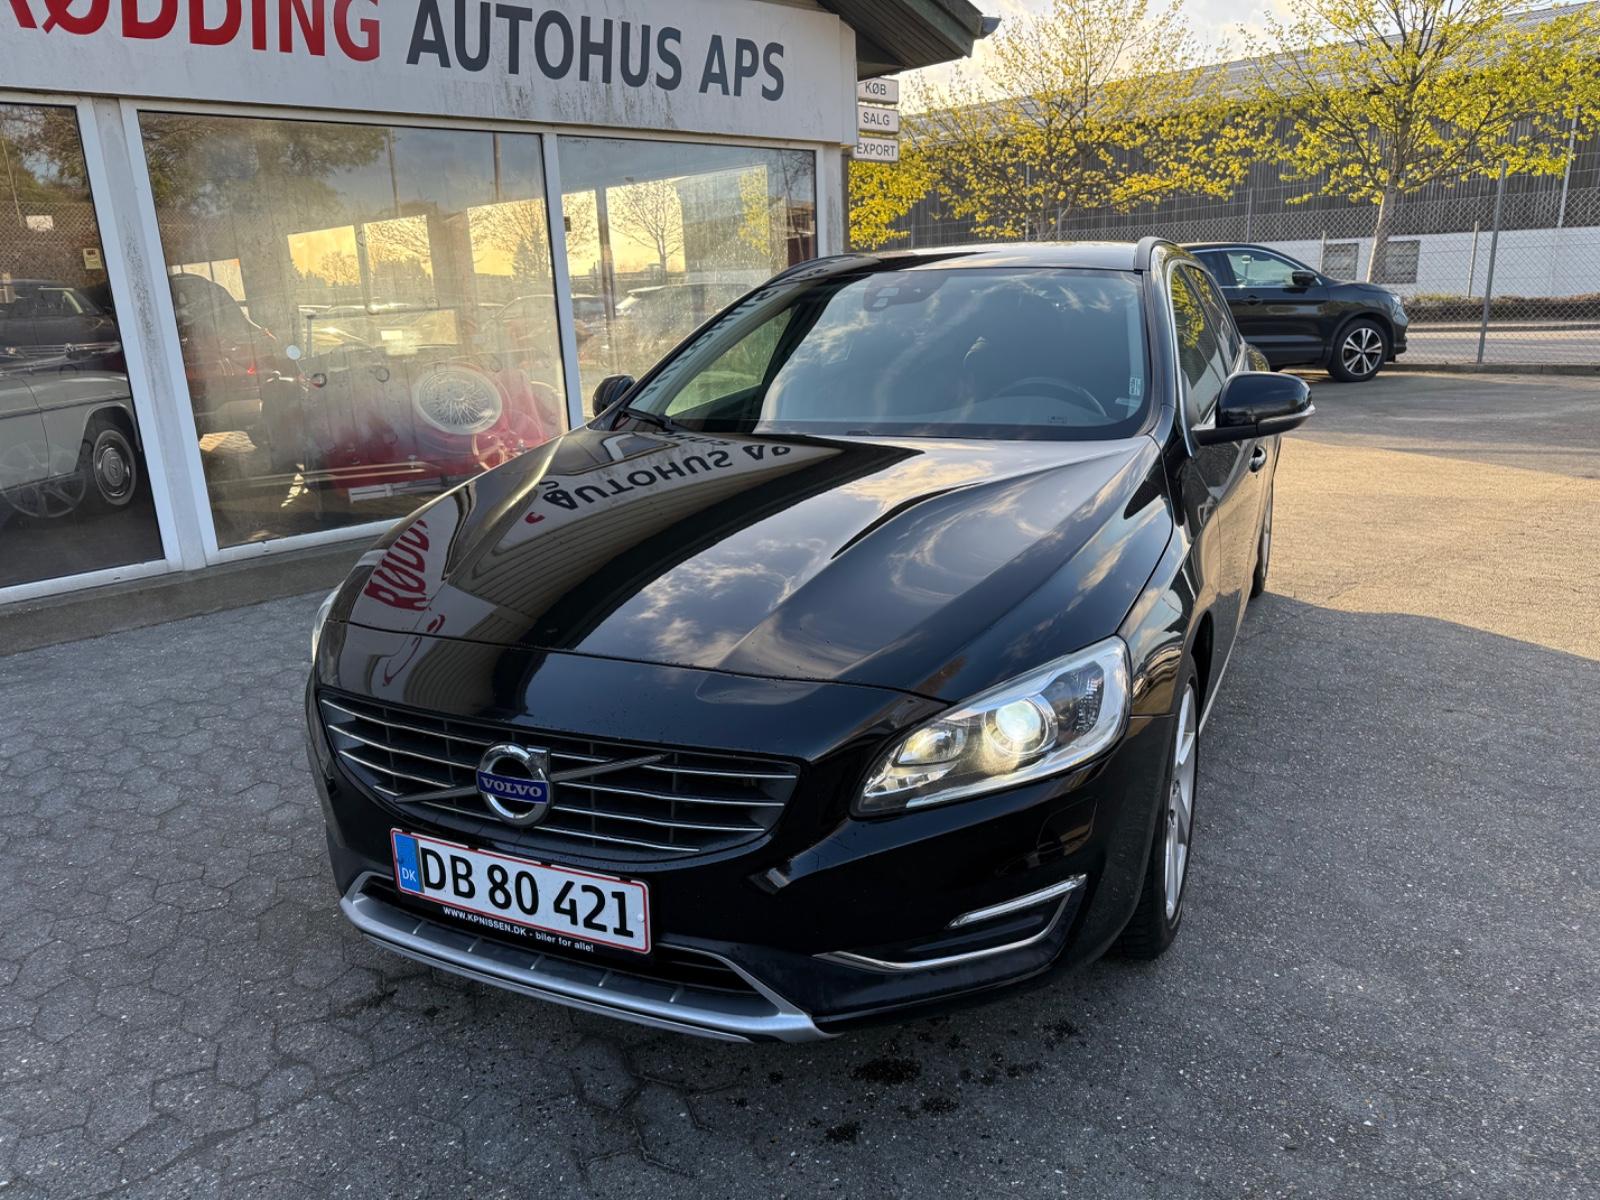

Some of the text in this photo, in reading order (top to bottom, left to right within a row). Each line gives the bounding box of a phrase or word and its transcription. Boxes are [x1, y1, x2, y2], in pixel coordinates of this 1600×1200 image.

[9, 0, 784, 101] DING AUTOHUS APS
[865, 82, 887, 96] KØB
[863, 111, 890, 126] SALG
[856, 142, 896, 157] EXPORT
[480, 776, 542, 797] VOLVO
[401, 867, 417, 882] DK
[420, 847, 634, 938] DB 80 421
[442, 906, 527, 937] WWW.KPNISSEN.DK
[535, 931, 556, 943] biler
[558, 936, 571, 948] for
